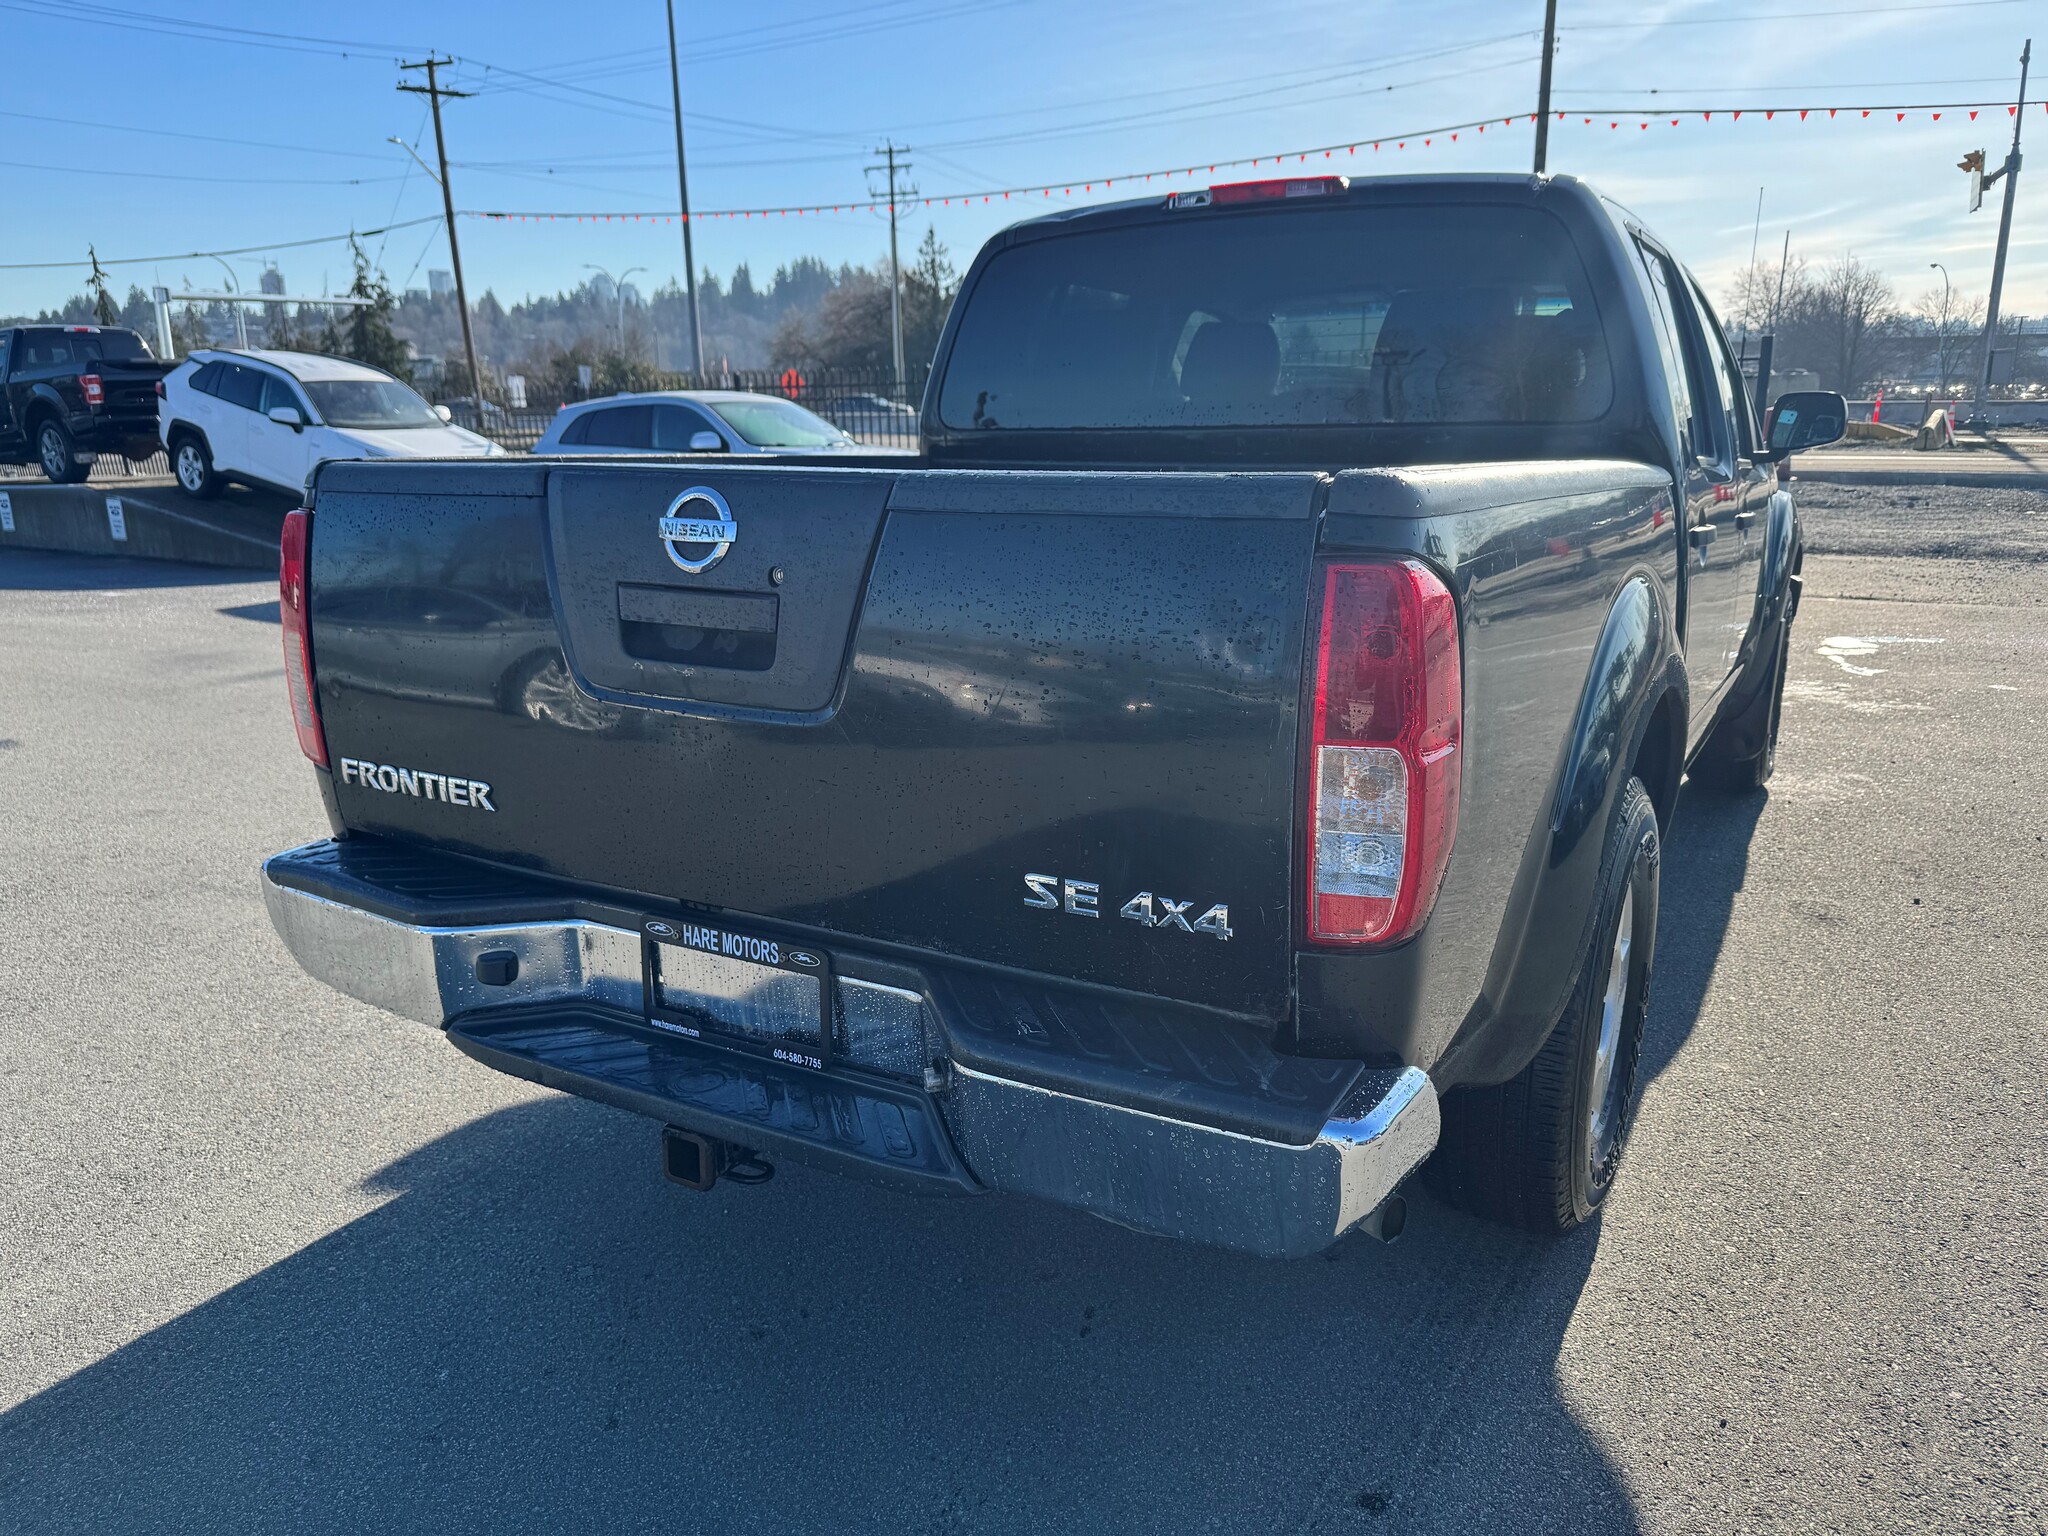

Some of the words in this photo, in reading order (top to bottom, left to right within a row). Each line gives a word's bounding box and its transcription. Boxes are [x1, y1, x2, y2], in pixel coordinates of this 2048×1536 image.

[663, 521, 726, 538] NISSAN
[340, 757, 495, 812] FRONTIER
[1024, 872, 1099, 918] SE
[683, 924, 719, 952] HARE
[722, 932, 779, 964] MOTORS
[773, 1048, 822, 1069] 604-580-7755
